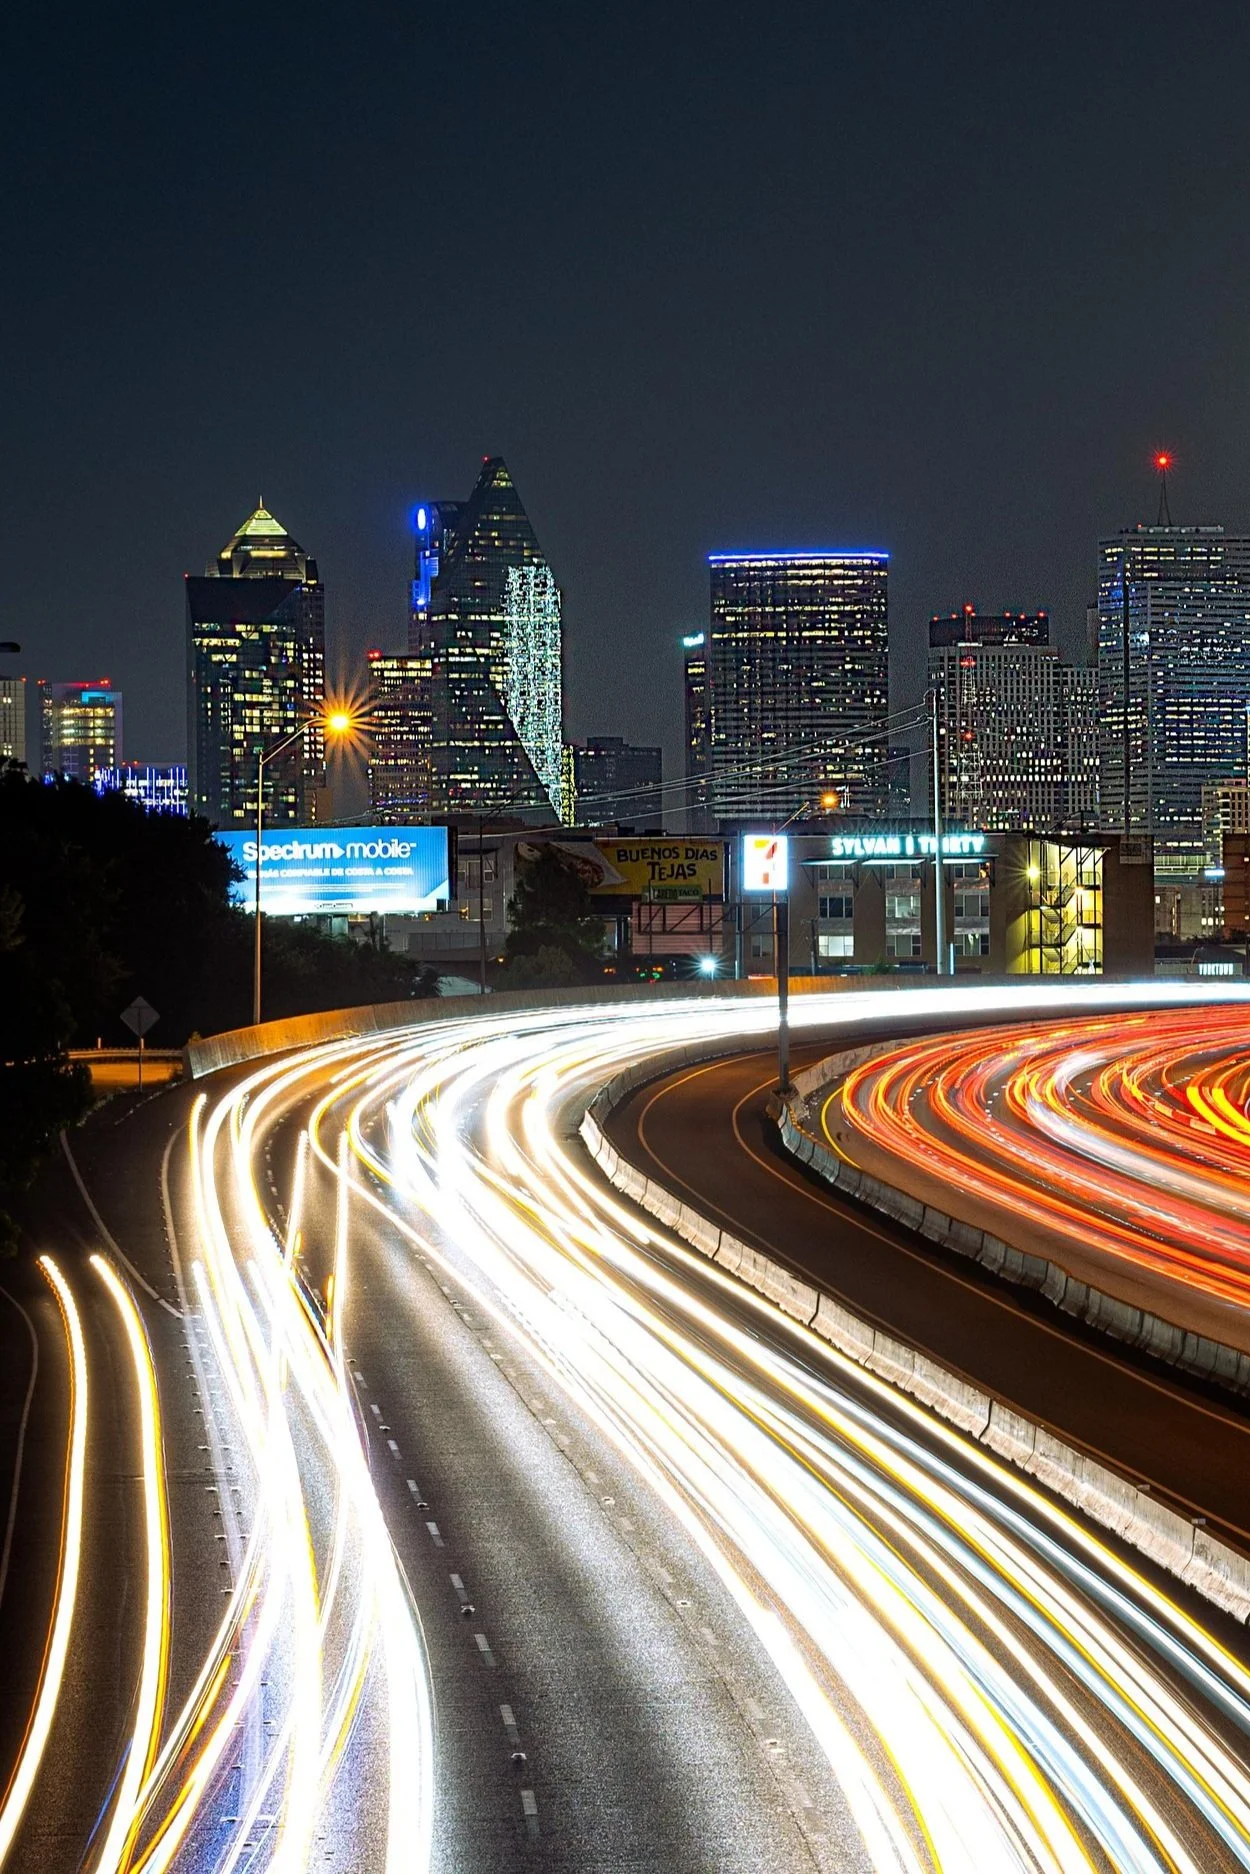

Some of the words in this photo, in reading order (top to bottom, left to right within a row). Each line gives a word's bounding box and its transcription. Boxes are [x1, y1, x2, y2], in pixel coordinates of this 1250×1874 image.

[243, 841, 337, 865] Spectrum
[617, 847, 679, 862] BUENOS
[685, 848, 717, 860] DIAS
[832, 837, 900, 855] SYLVAN
[647, 862, 696, 881] TEJAS
